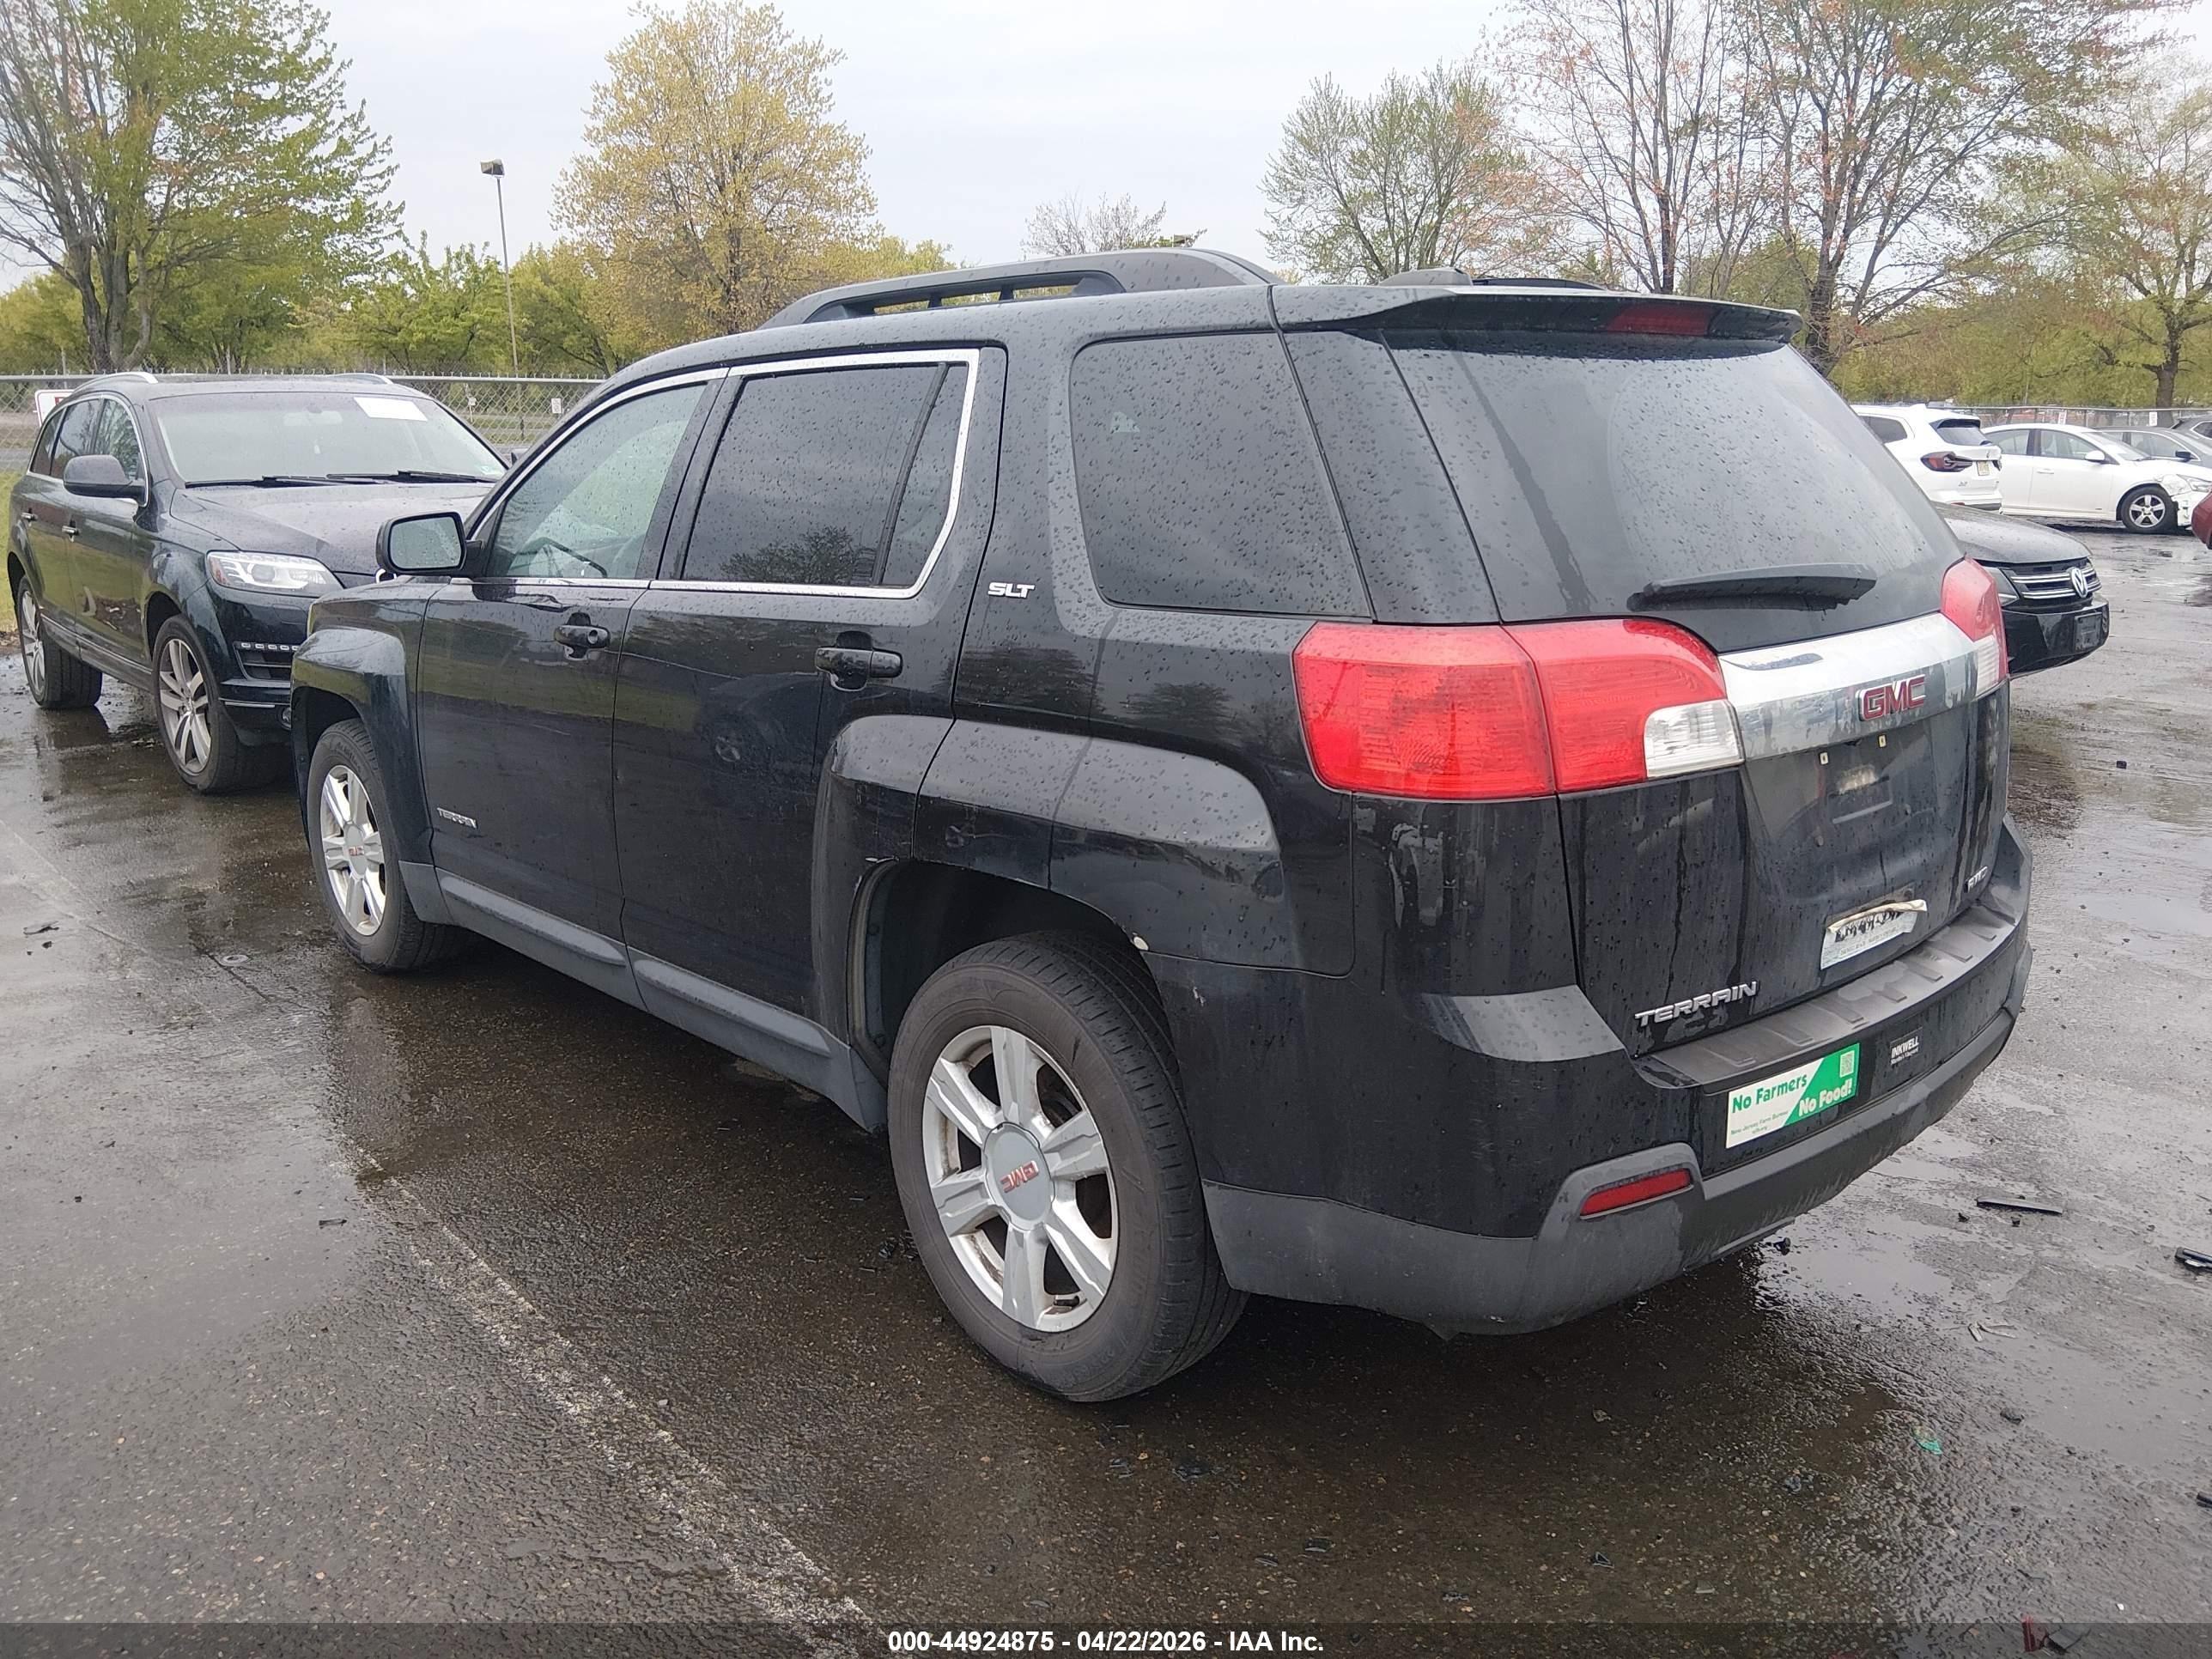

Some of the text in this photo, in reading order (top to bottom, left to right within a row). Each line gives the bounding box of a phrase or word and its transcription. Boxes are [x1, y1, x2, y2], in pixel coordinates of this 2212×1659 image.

[988, 581, 1036, 599] SLT
[1857, 673, 1927, 720] GMC
[1634, 981, 1757, 1028] TERRAIN
[1891, 1036, 1920, 1059] INKWELL
[1731, 1073, 1808, 1114] No Farmers
[1798, 1078, 1853, 1117] No Food!
[1000, 1160, 1039, 1194] GMC
